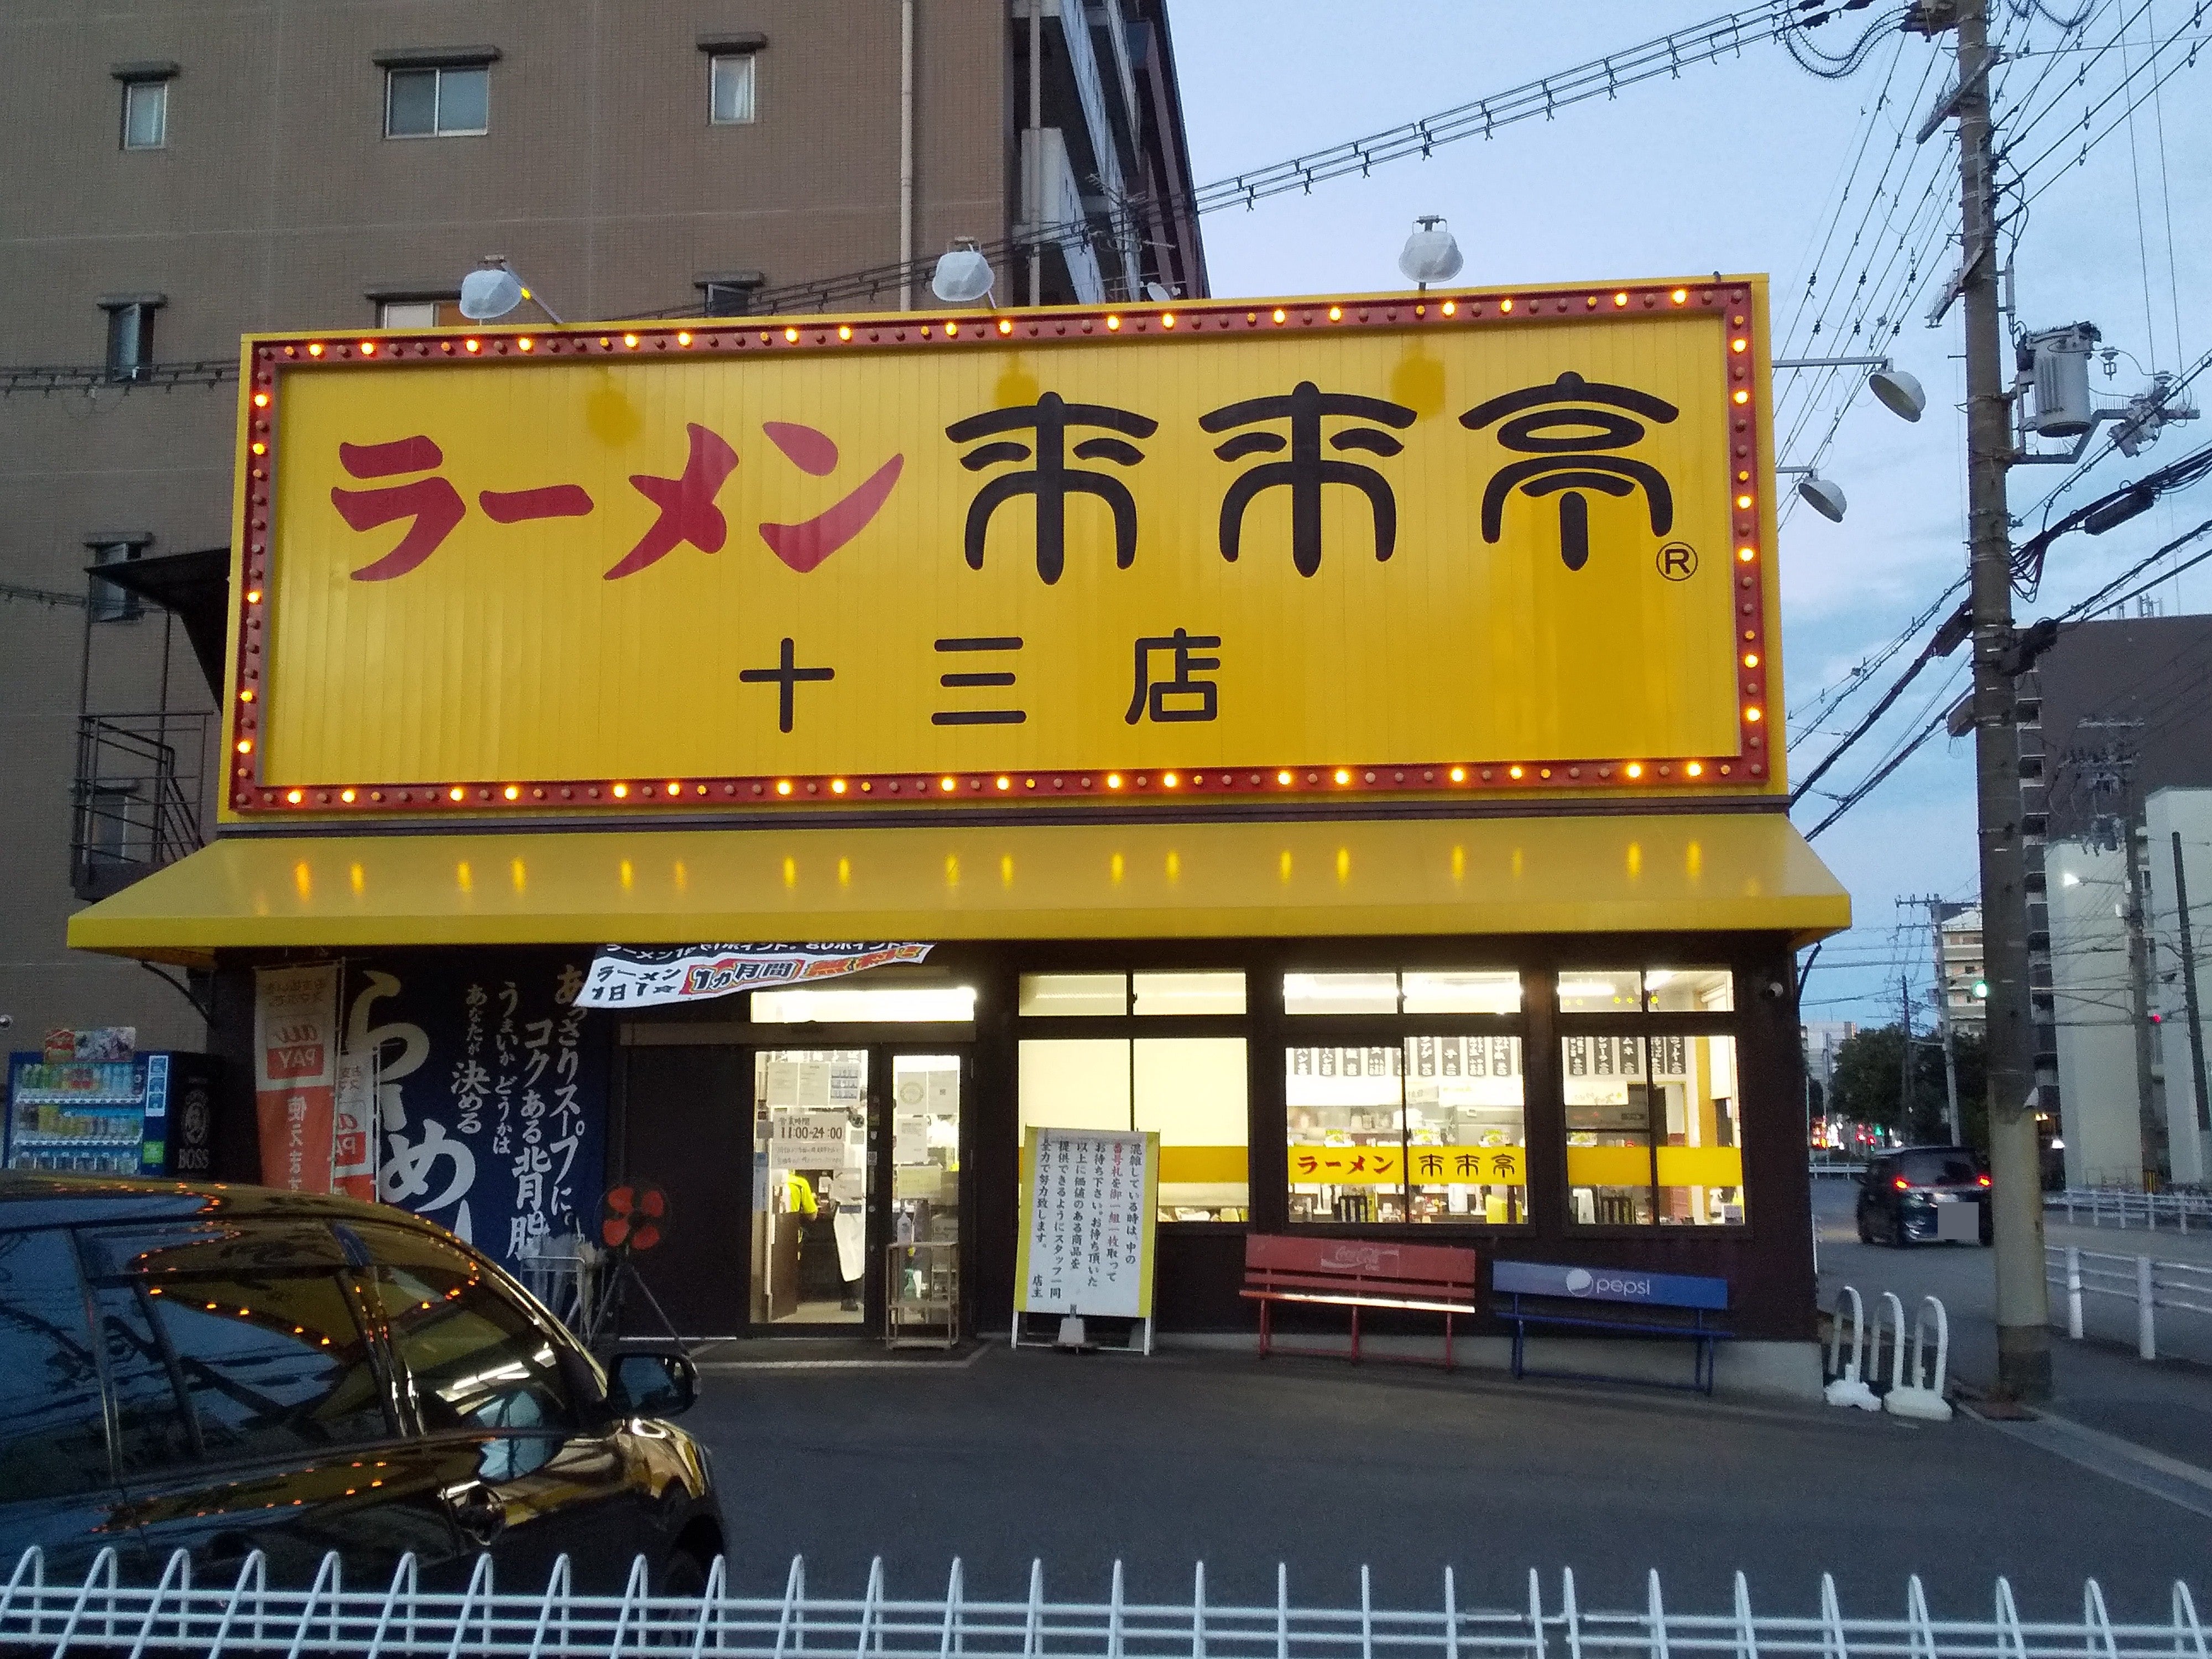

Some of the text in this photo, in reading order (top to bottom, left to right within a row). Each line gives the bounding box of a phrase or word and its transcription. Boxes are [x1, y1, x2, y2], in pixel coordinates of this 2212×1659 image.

[332, 421, 903, 580] ラーメン
[946, 372, 1679, 583] 来来亭
[739, 628, 1220, 733] 十三店
[597, 966, 681, 983] ラーメン
[346, 969, 476, 1244] らーめ
[450, 984, 492, 1134] あなたが決める
[493, 981, 519, 1154] うまいかどうかは
[549, 963, 587, 1215] あっさりスープに
[1297, 1153, 1516, 1178] ラーメン 来来亭
[1596, 1278, 1651, 1296] pepsi
